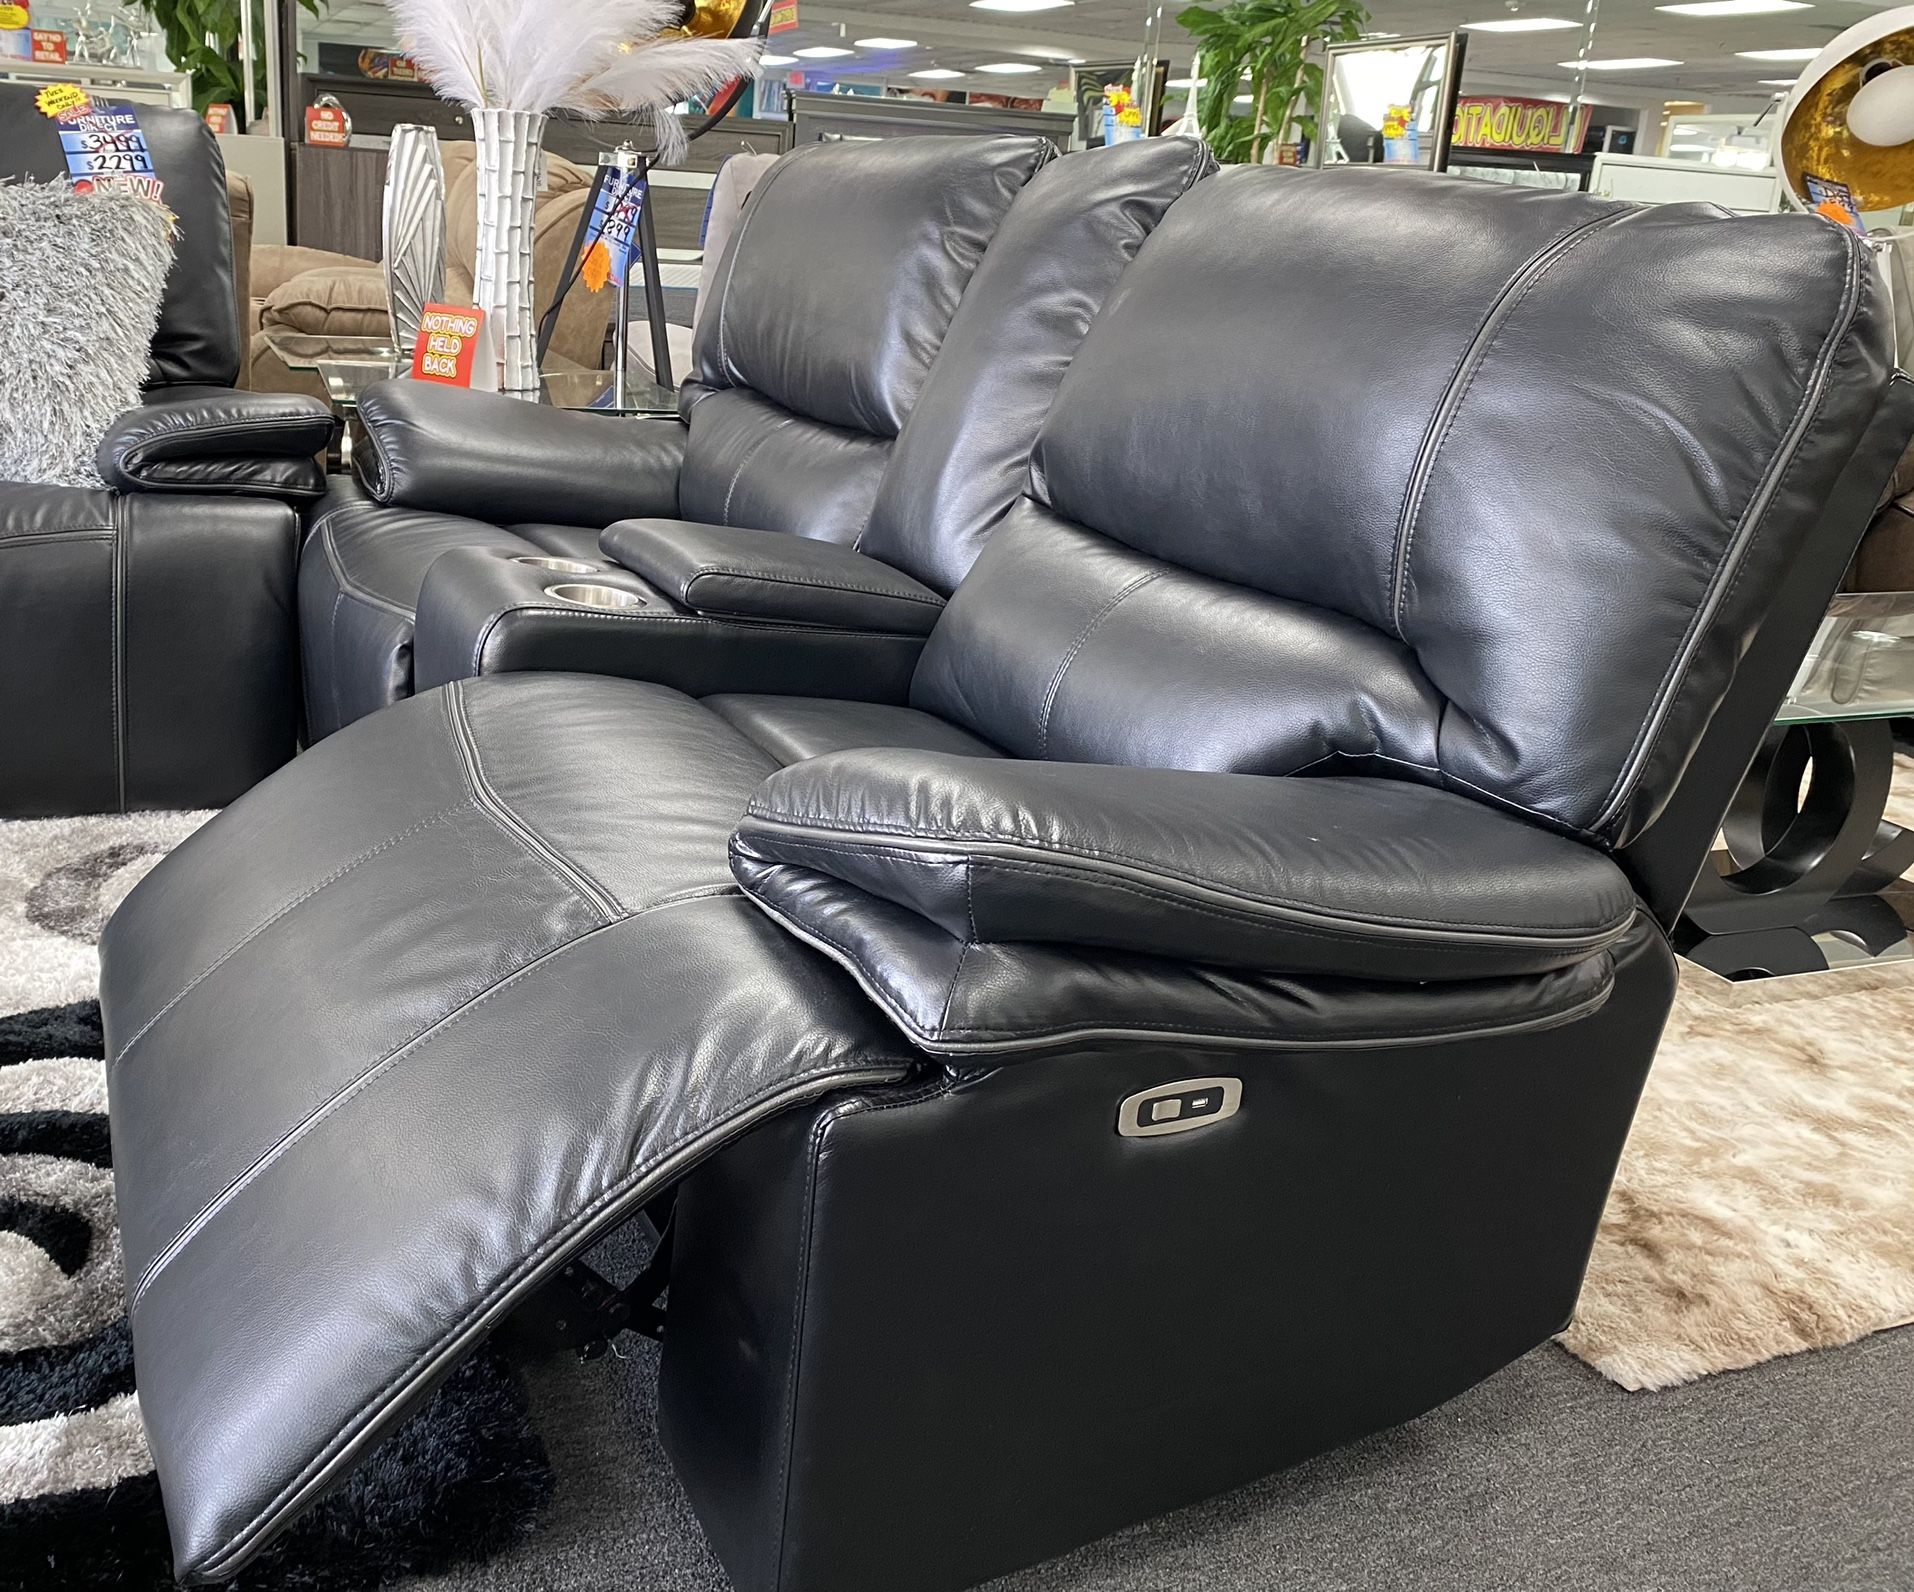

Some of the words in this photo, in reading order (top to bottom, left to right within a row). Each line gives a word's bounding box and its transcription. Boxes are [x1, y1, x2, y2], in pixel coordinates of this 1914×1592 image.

[86, 154, 149, 172] $2299
[421, 312, 477, 337] NOTHING
[428, 334, 462, 355] HELD
[422, 354, 456, 377] BACK
